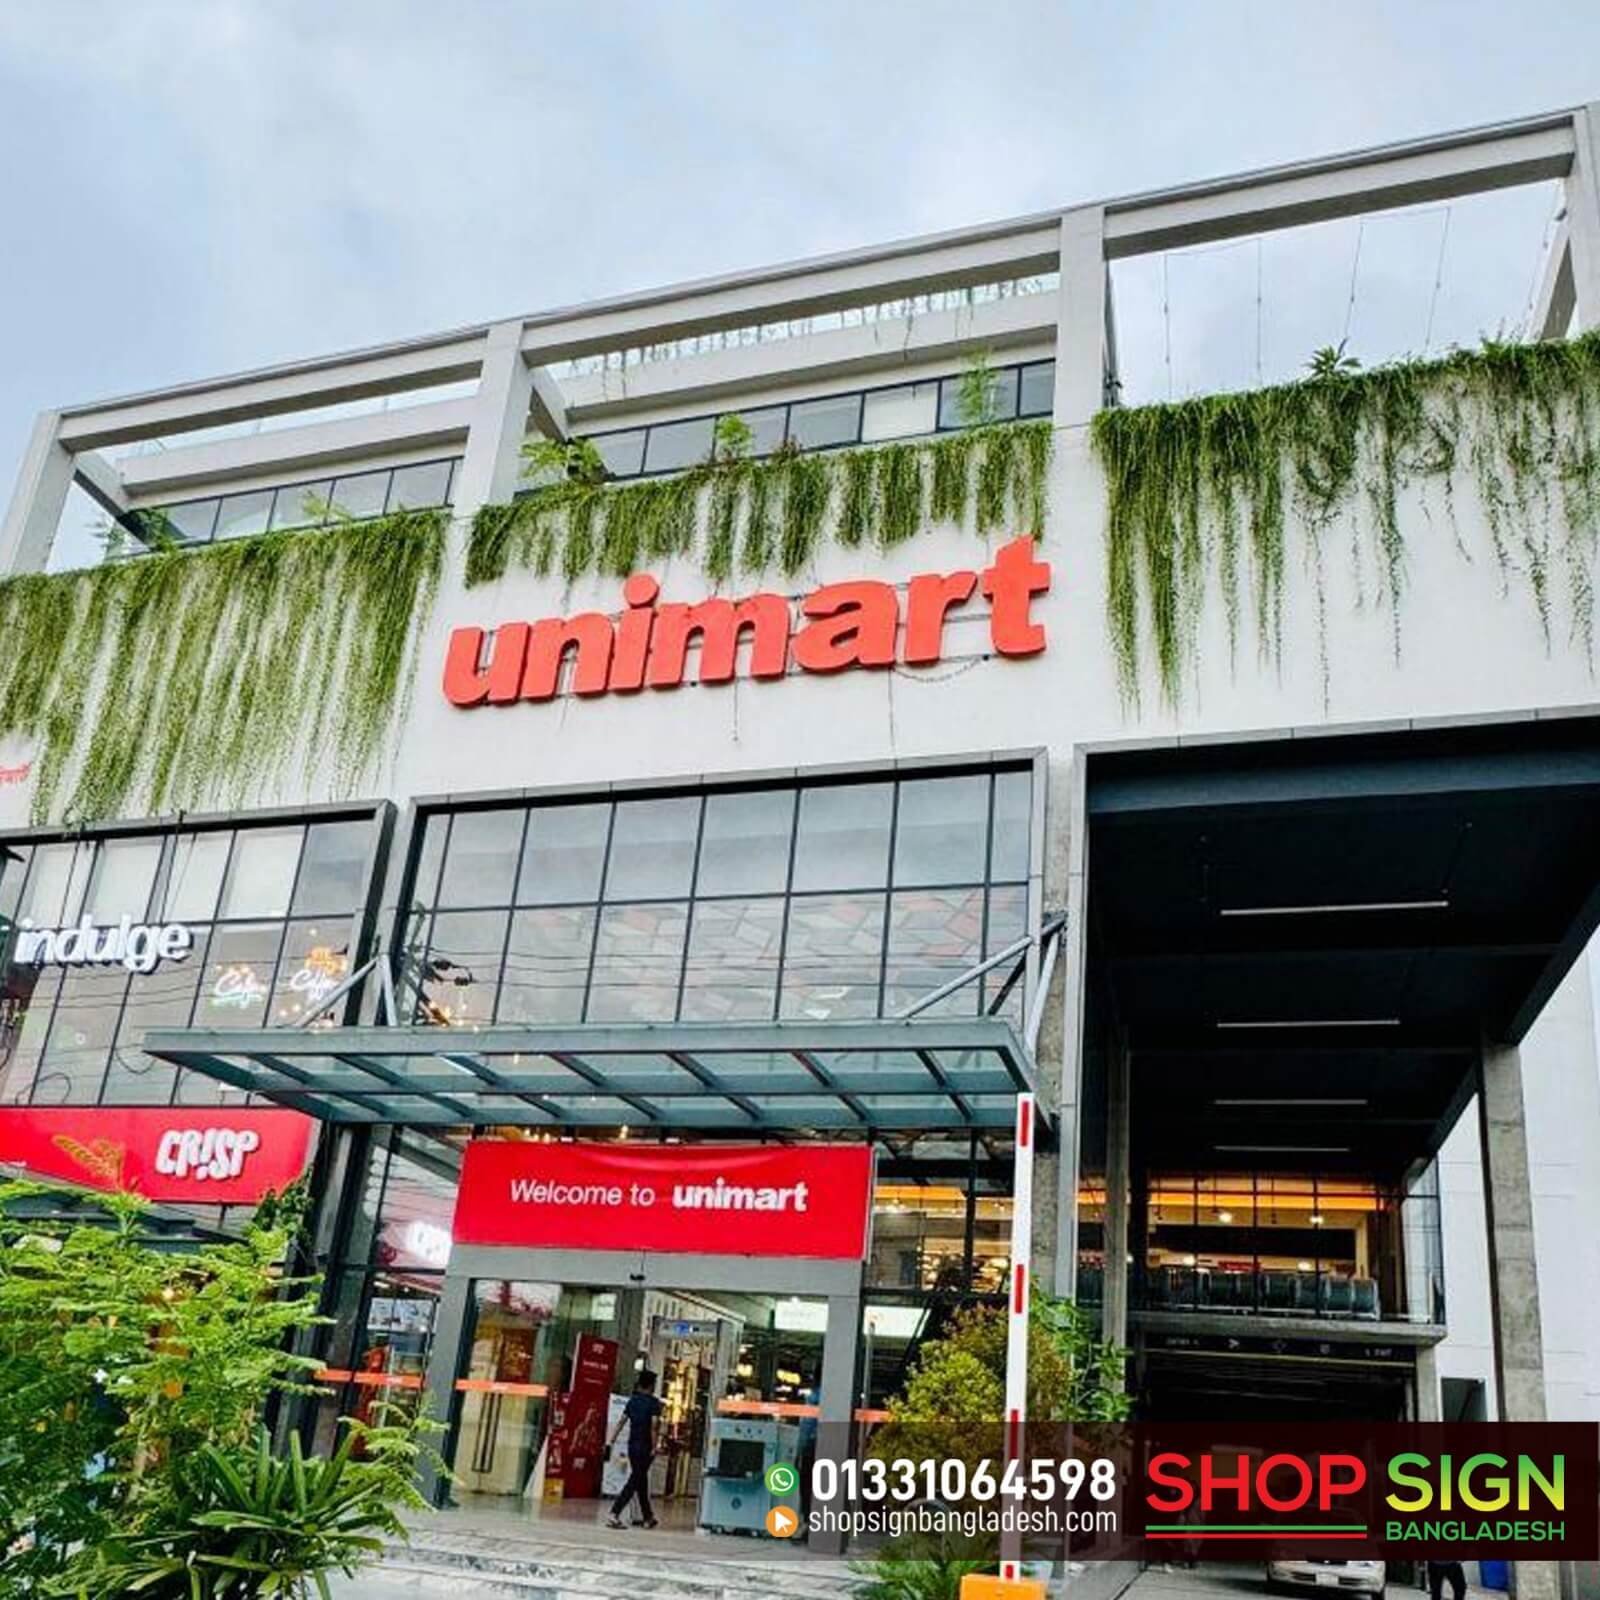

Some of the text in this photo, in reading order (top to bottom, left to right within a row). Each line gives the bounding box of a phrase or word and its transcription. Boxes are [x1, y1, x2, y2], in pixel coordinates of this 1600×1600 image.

[442, 534, 1051, 709] unimart
[13, 914, 192, 973] indulge
[510, 1177, 808, 1211] Welcome to unimart
